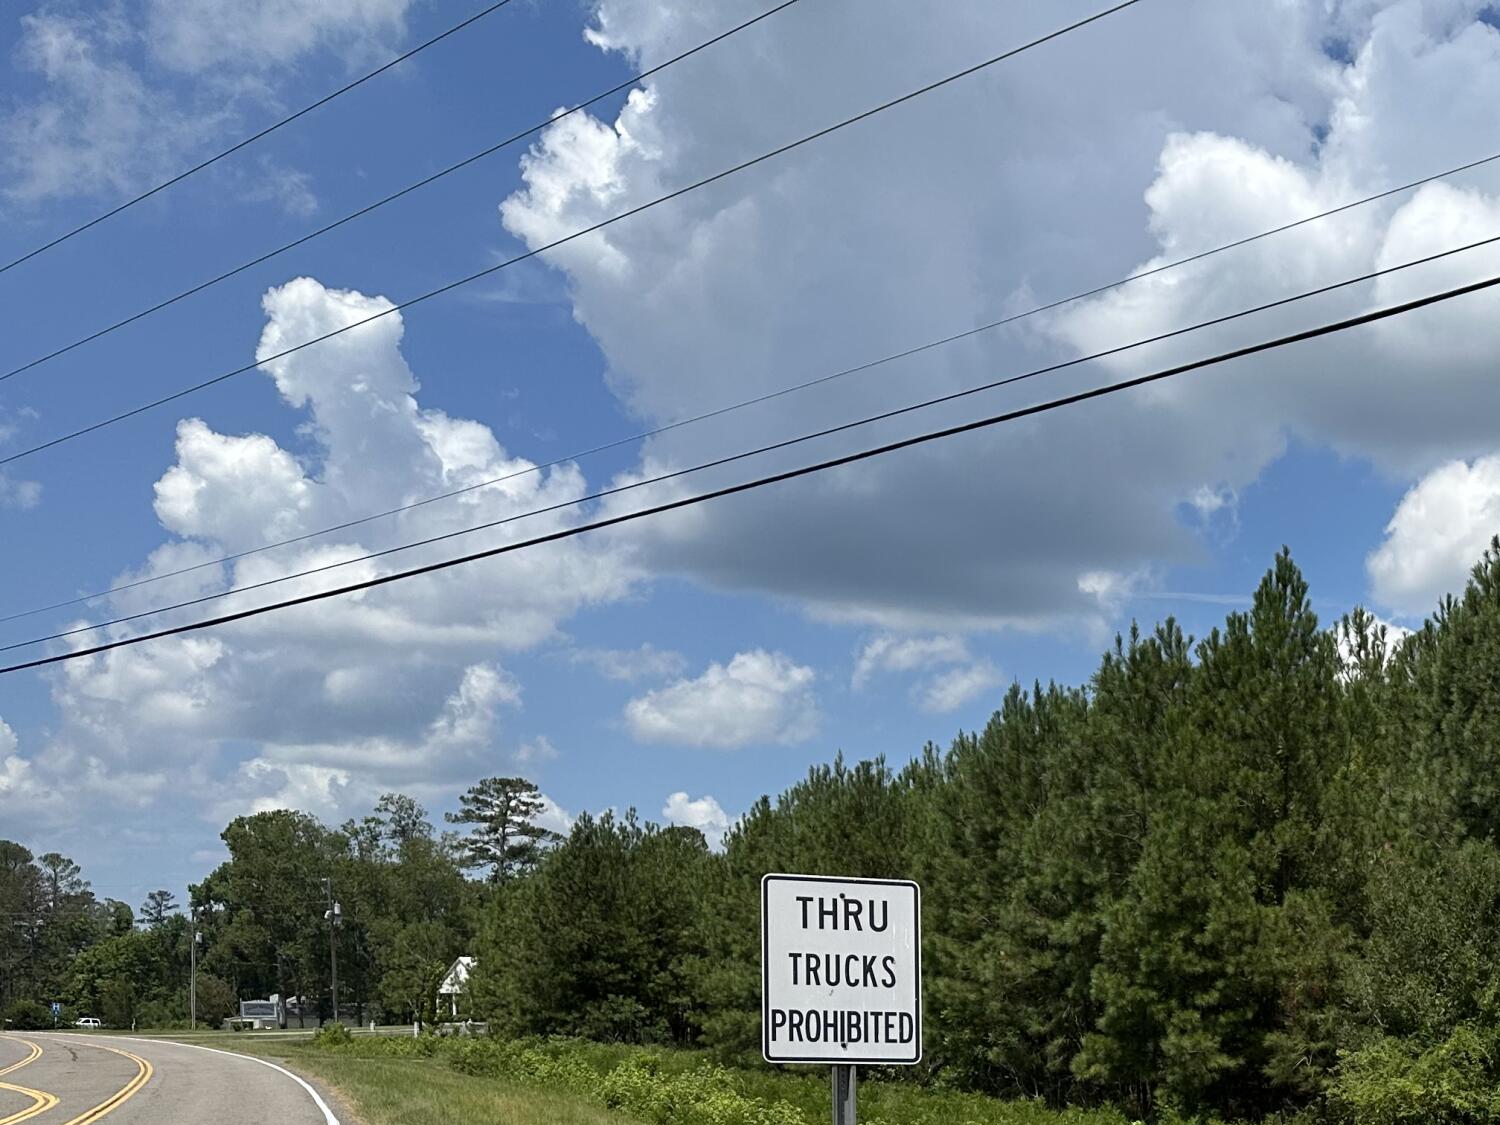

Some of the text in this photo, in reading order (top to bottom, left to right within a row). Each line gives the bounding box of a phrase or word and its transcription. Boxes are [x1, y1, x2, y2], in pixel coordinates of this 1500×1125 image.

[796, 896, 888, 932] THRU
[788, 953, 897, 988] TRUCKS
[771, 1009, 914, 1044] PROHIBITED
